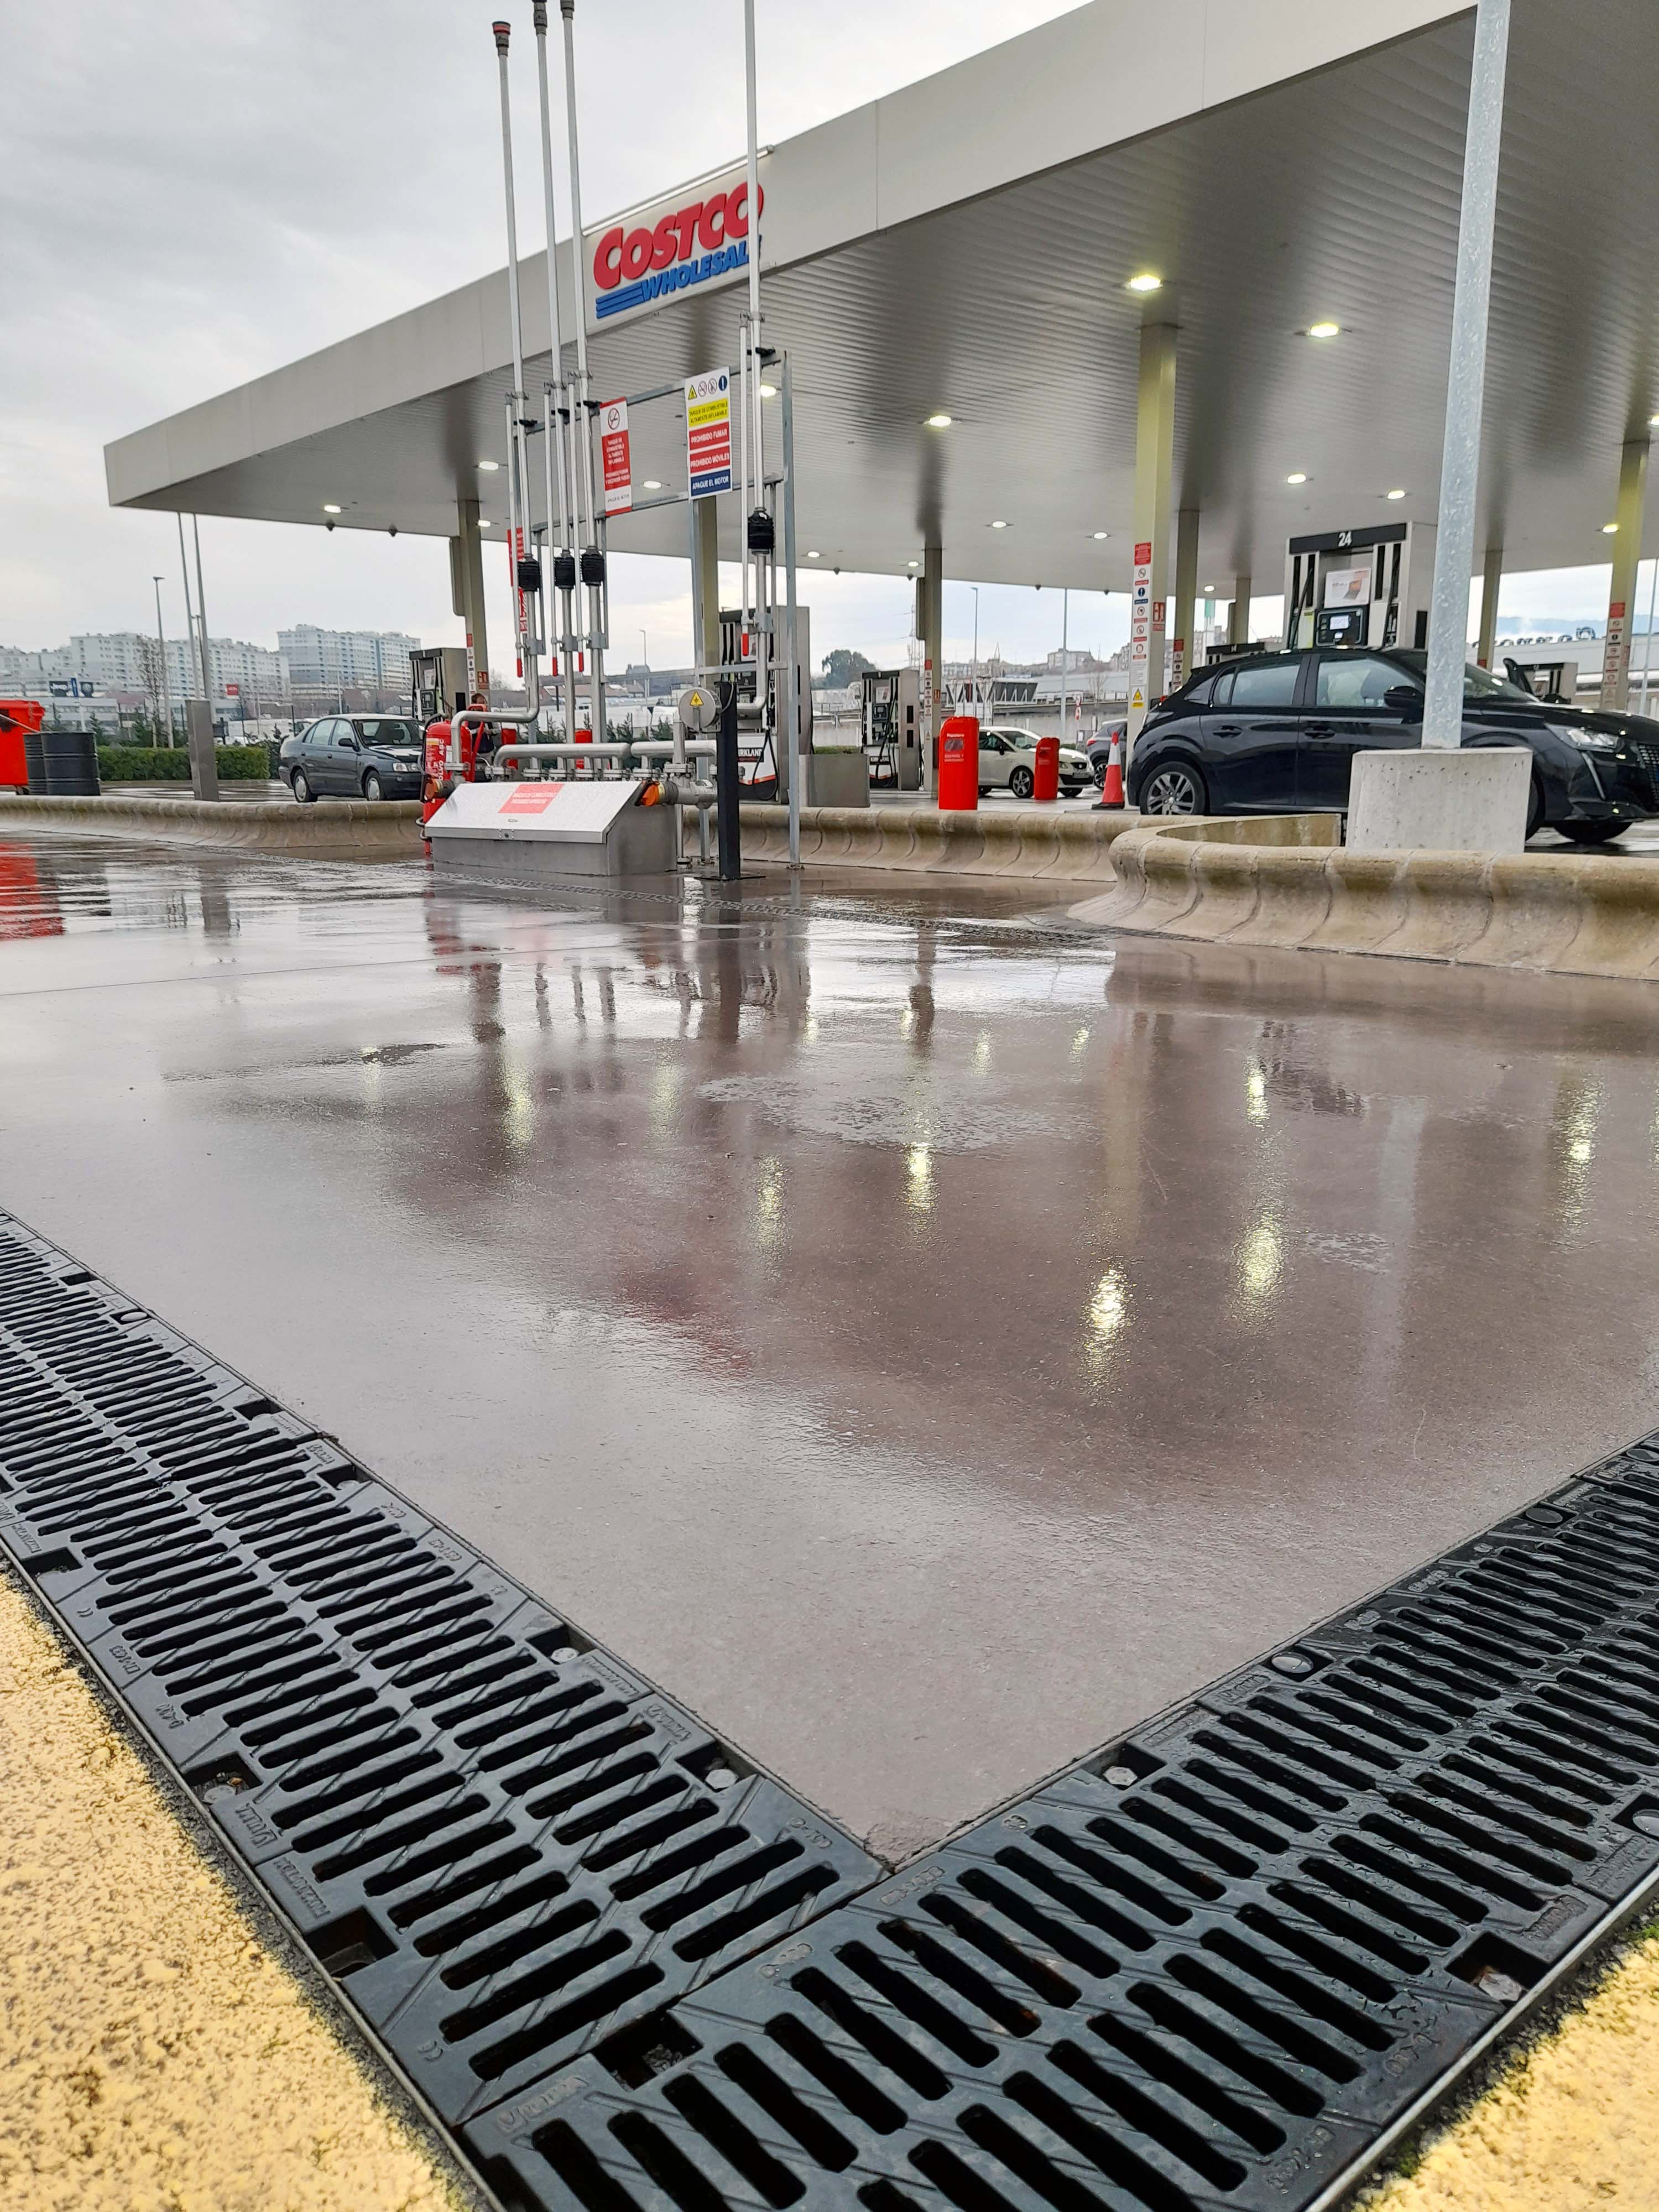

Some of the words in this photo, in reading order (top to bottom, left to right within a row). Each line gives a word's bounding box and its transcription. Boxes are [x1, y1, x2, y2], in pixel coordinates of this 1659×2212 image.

[593, 181, 764, 289] COSTCO
[641, 234, 761, 301] WHOLESAL
[691, 432, 713, 444] PROHIBIDO
[713, 429, 727, 439] FUMAR
[690, 457, 712, 468] PROHIBIDO
[692, 479, 708, 490] APAGUE
[708, 478, 714, 487] EL
[714, 476, 729, 486] MOTOR
[1338, 530, 1352, 547] 24
[738, 748, 763, 757] IRKLAND
